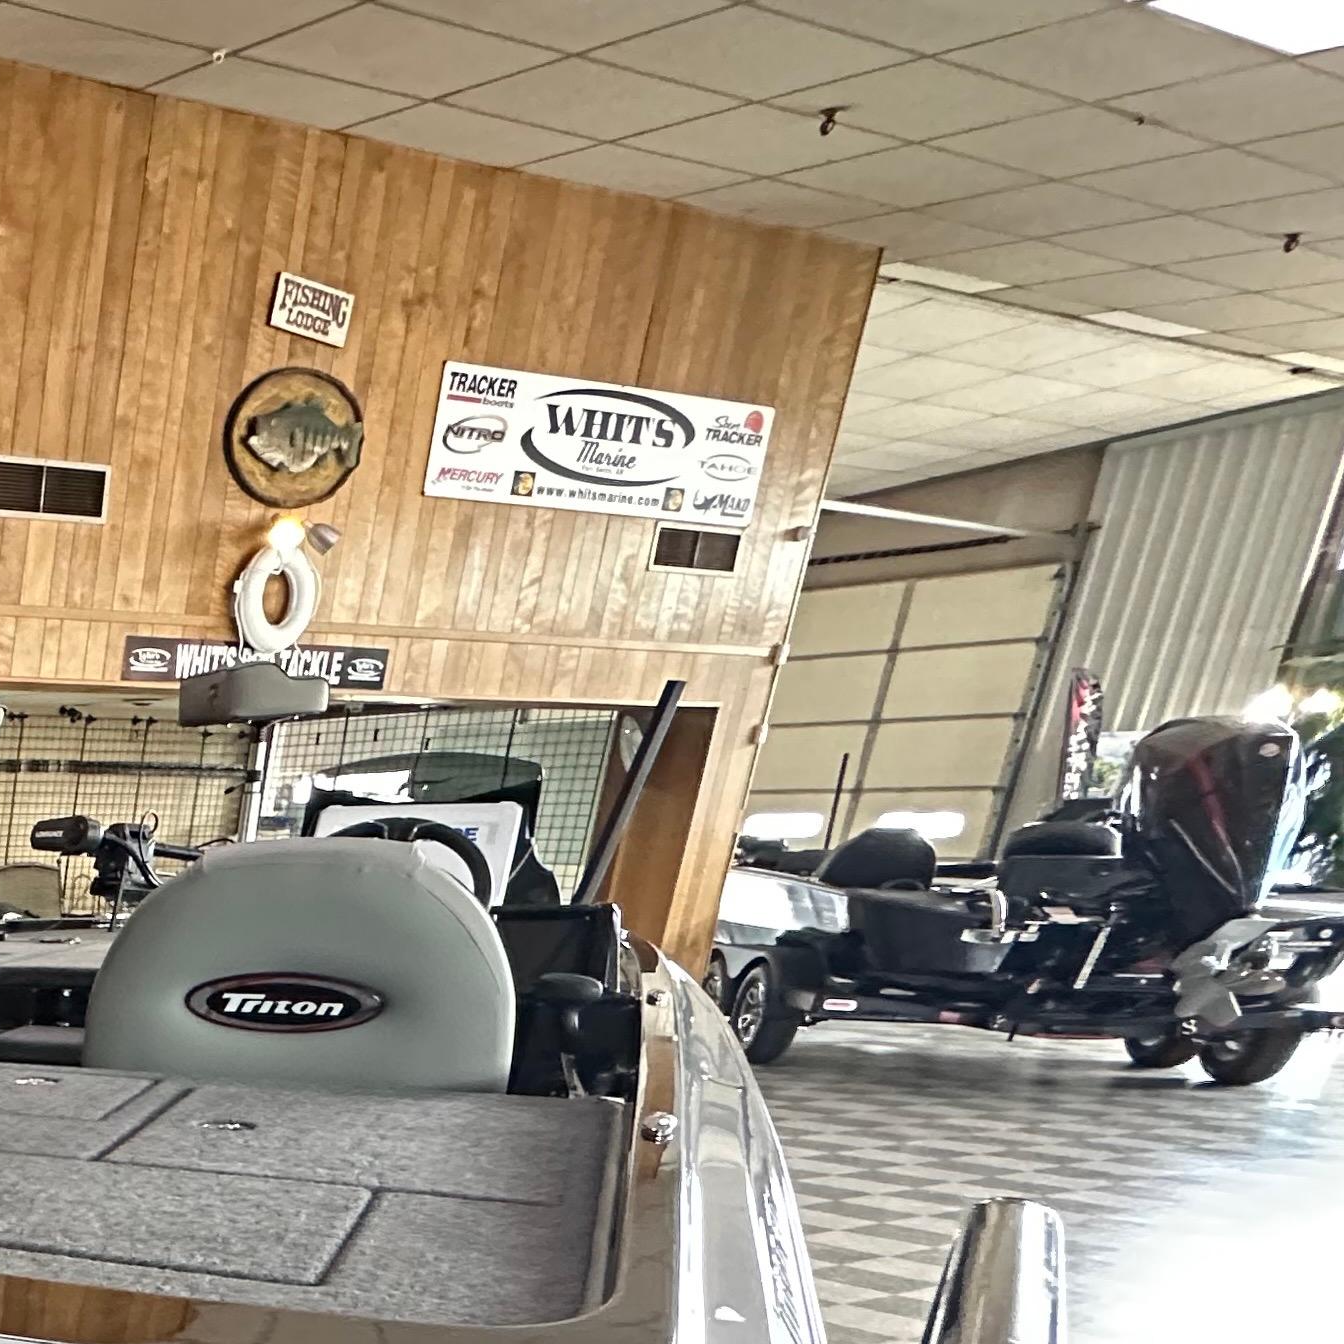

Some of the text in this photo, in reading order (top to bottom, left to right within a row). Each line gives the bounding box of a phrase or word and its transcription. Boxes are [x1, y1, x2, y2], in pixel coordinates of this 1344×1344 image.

[279, 278, 350, 328] FISHING
[286, 308, 332, 336] LODGE
[449, 371, 518, 399] TRACKER
[444, 424, 507, 443] NITRO
[546, 403, 676, 448] WHIT'S
[705, 428, 763, 447] TRACKER
[576, 439, 637, 469] Marine
[436, 466, 504, 485] MERCURY
[698, 460, 758, 475] TAHOE
[221, 992, 345, 1017] Triton
